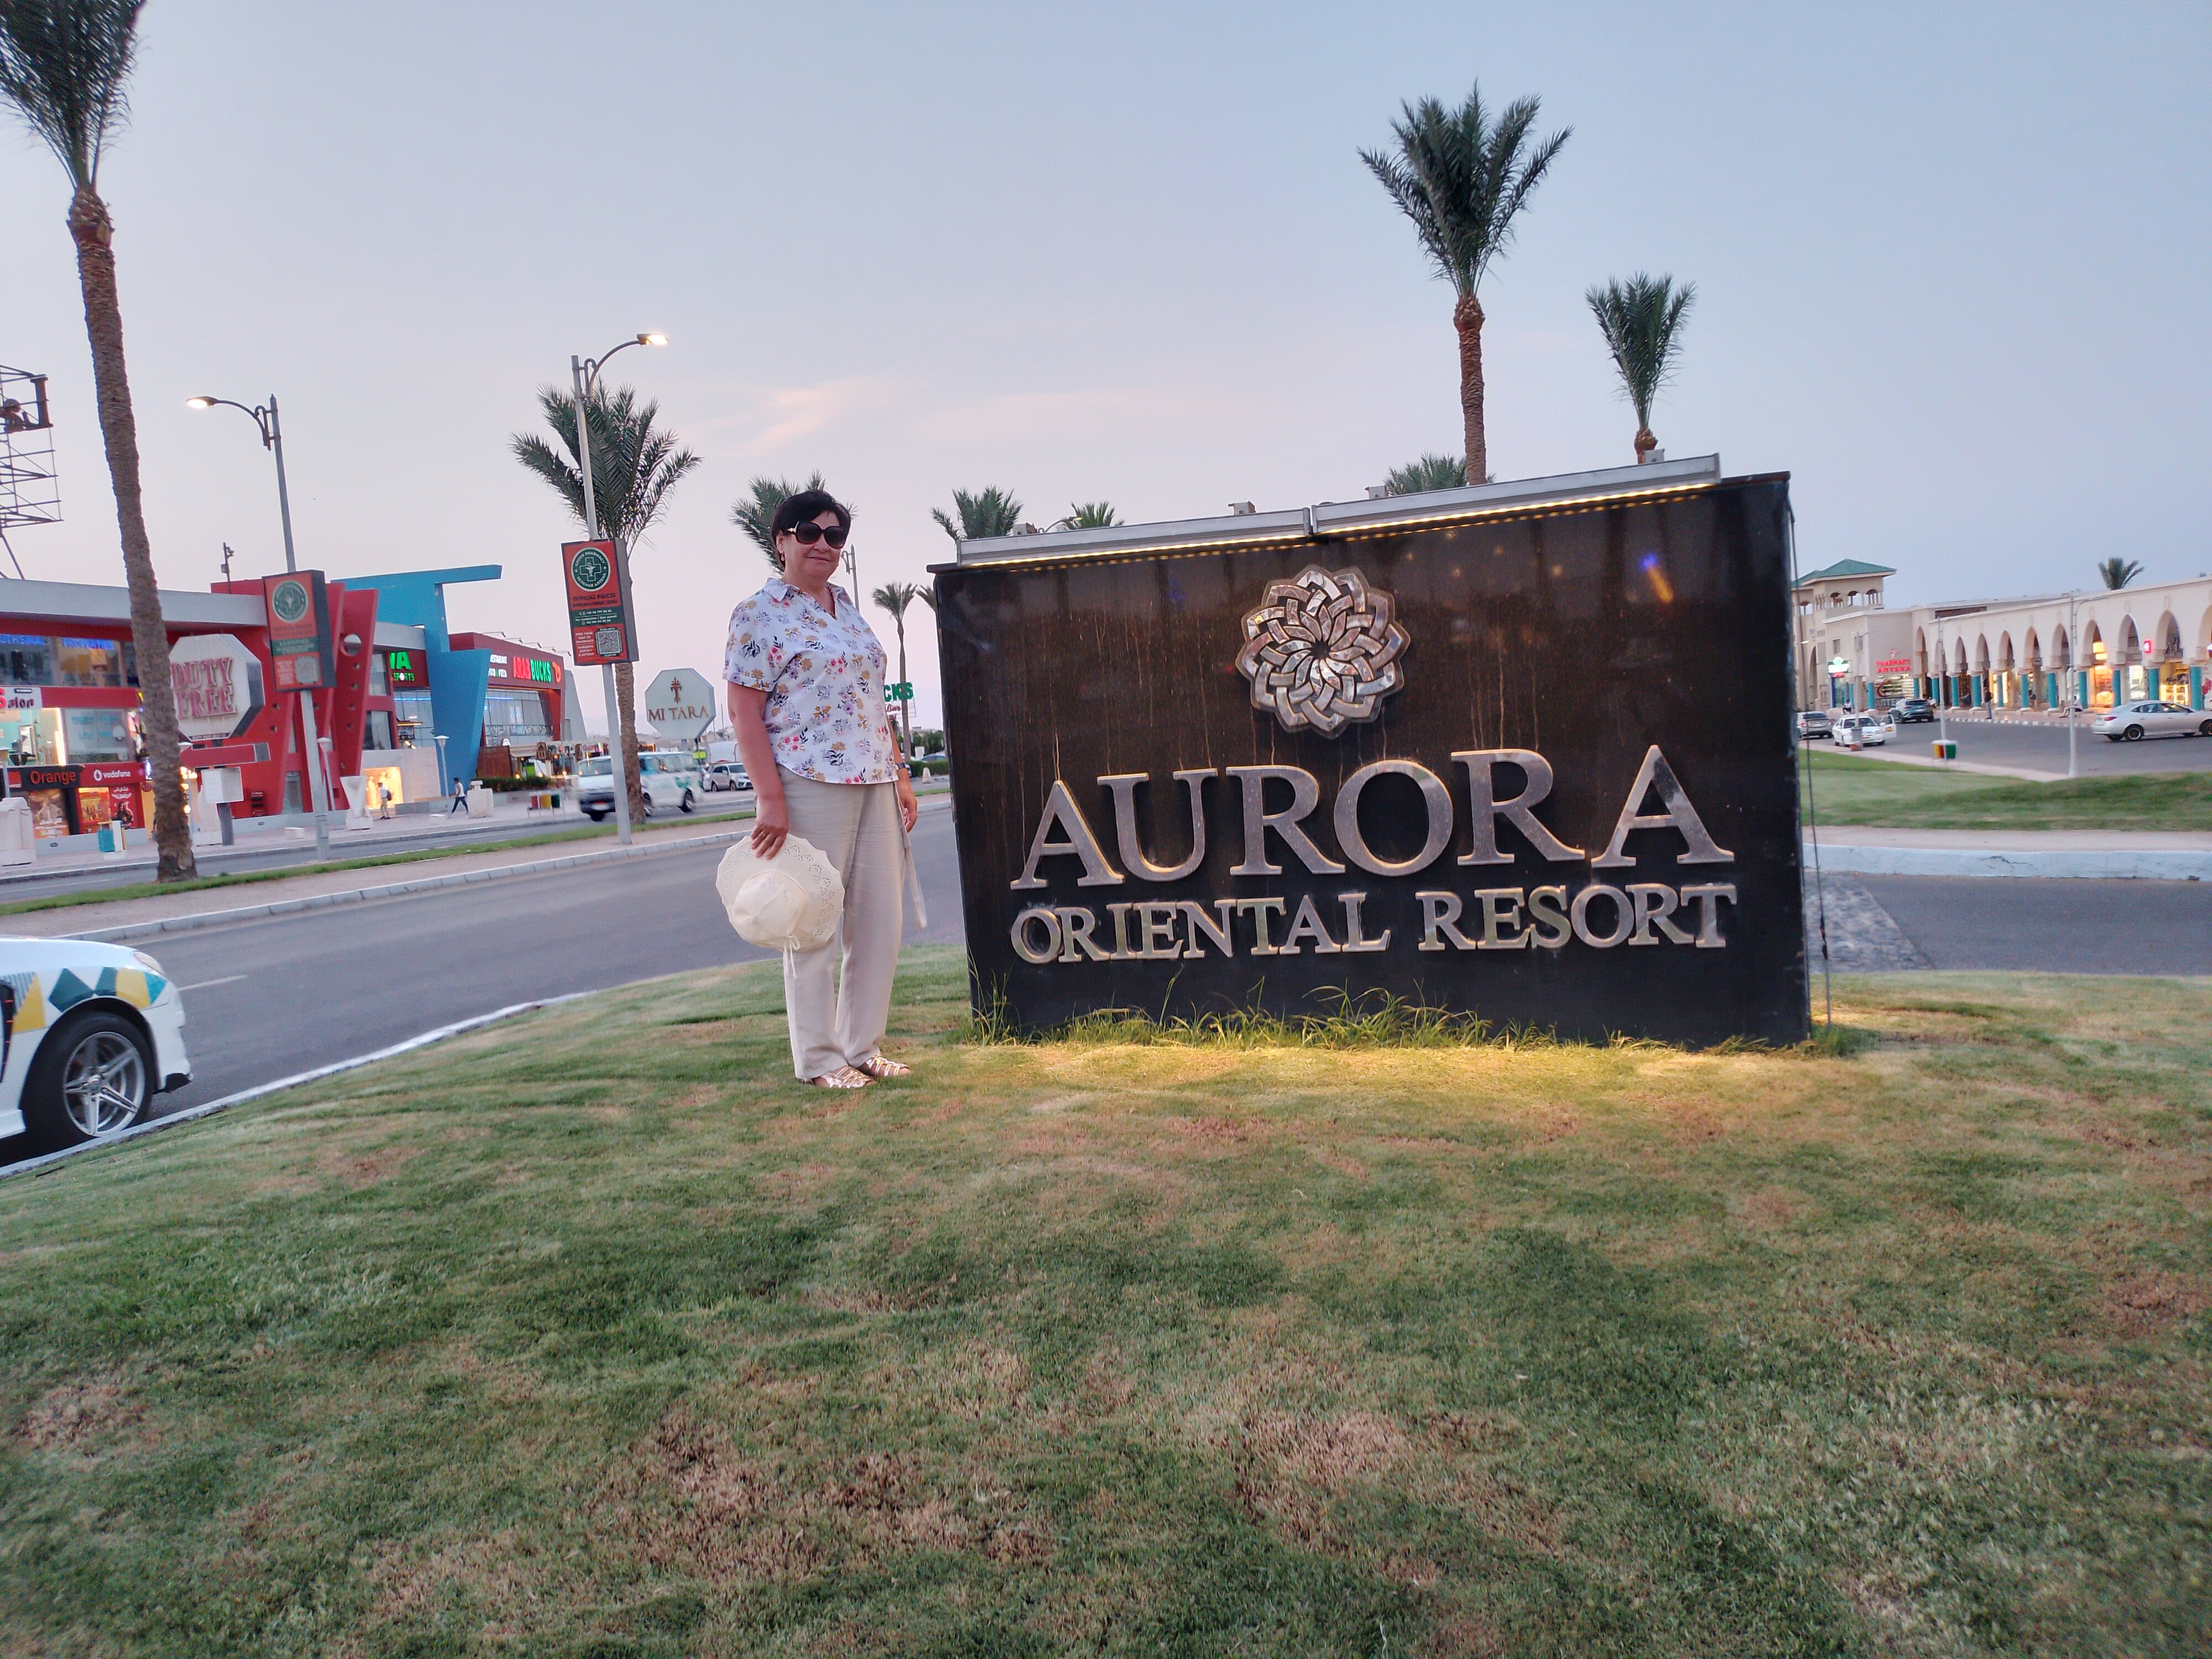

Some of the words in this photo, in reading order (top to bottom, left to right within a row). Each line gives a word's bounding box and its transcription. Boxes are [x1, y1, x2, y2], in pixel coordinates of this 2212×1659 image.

[575, 554, 585, 567] GREEN
[585, 551, 605, 564] PHARMACY
[594, 573, 606, 587] АПТЕКА
[170, 658, 233, 689] DUTY
[175, 685, 238, 719] FREE
[648, 708, 665, 721] MI
[667, 705, 709, 720] TARA
[30, 770, 76, 785] Orange
[103, 770, 131, 778] vodafone
[1010, 744, 1735, 890] AURORA
[1011, 891, 1391, 964] ORIENTAL
[1415, 883, 1738, 950] RESORT
